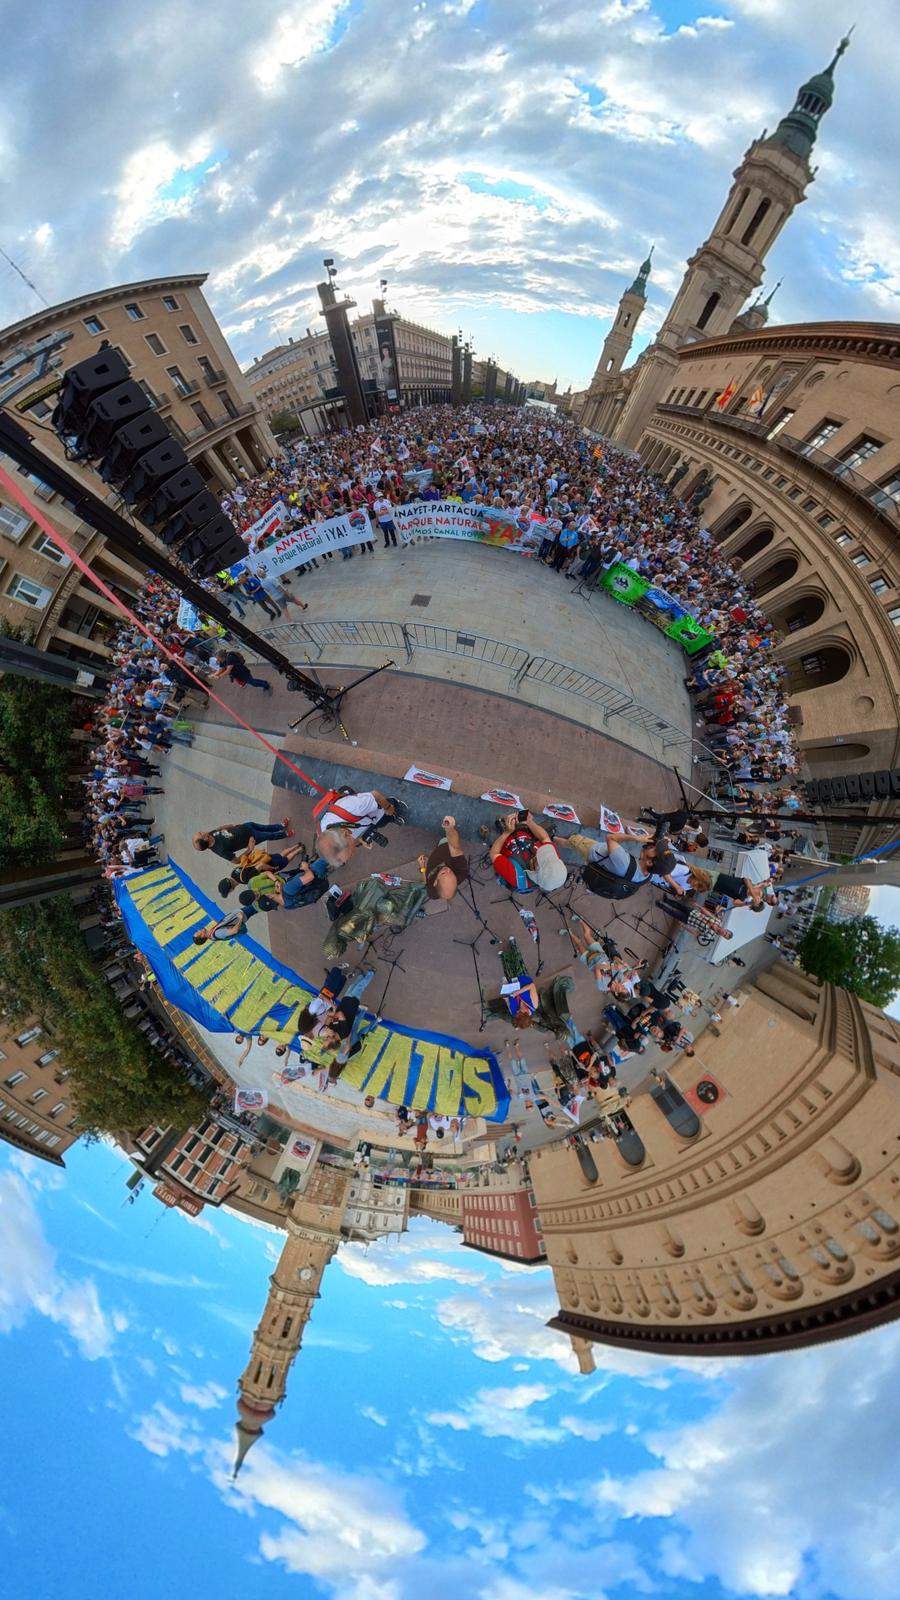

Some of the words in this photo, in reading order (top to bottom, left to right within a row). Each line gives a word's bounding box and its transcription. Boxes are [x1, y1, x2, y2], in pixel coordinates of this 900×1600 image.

[434, 528, 460, 537] CANAL
[435, 516, 482, 530] NATURAL
[275, 526, 318, 554] ANAYET
[271, 547, 297, 567] Parque
[296, 536, 322, 553] Natural
